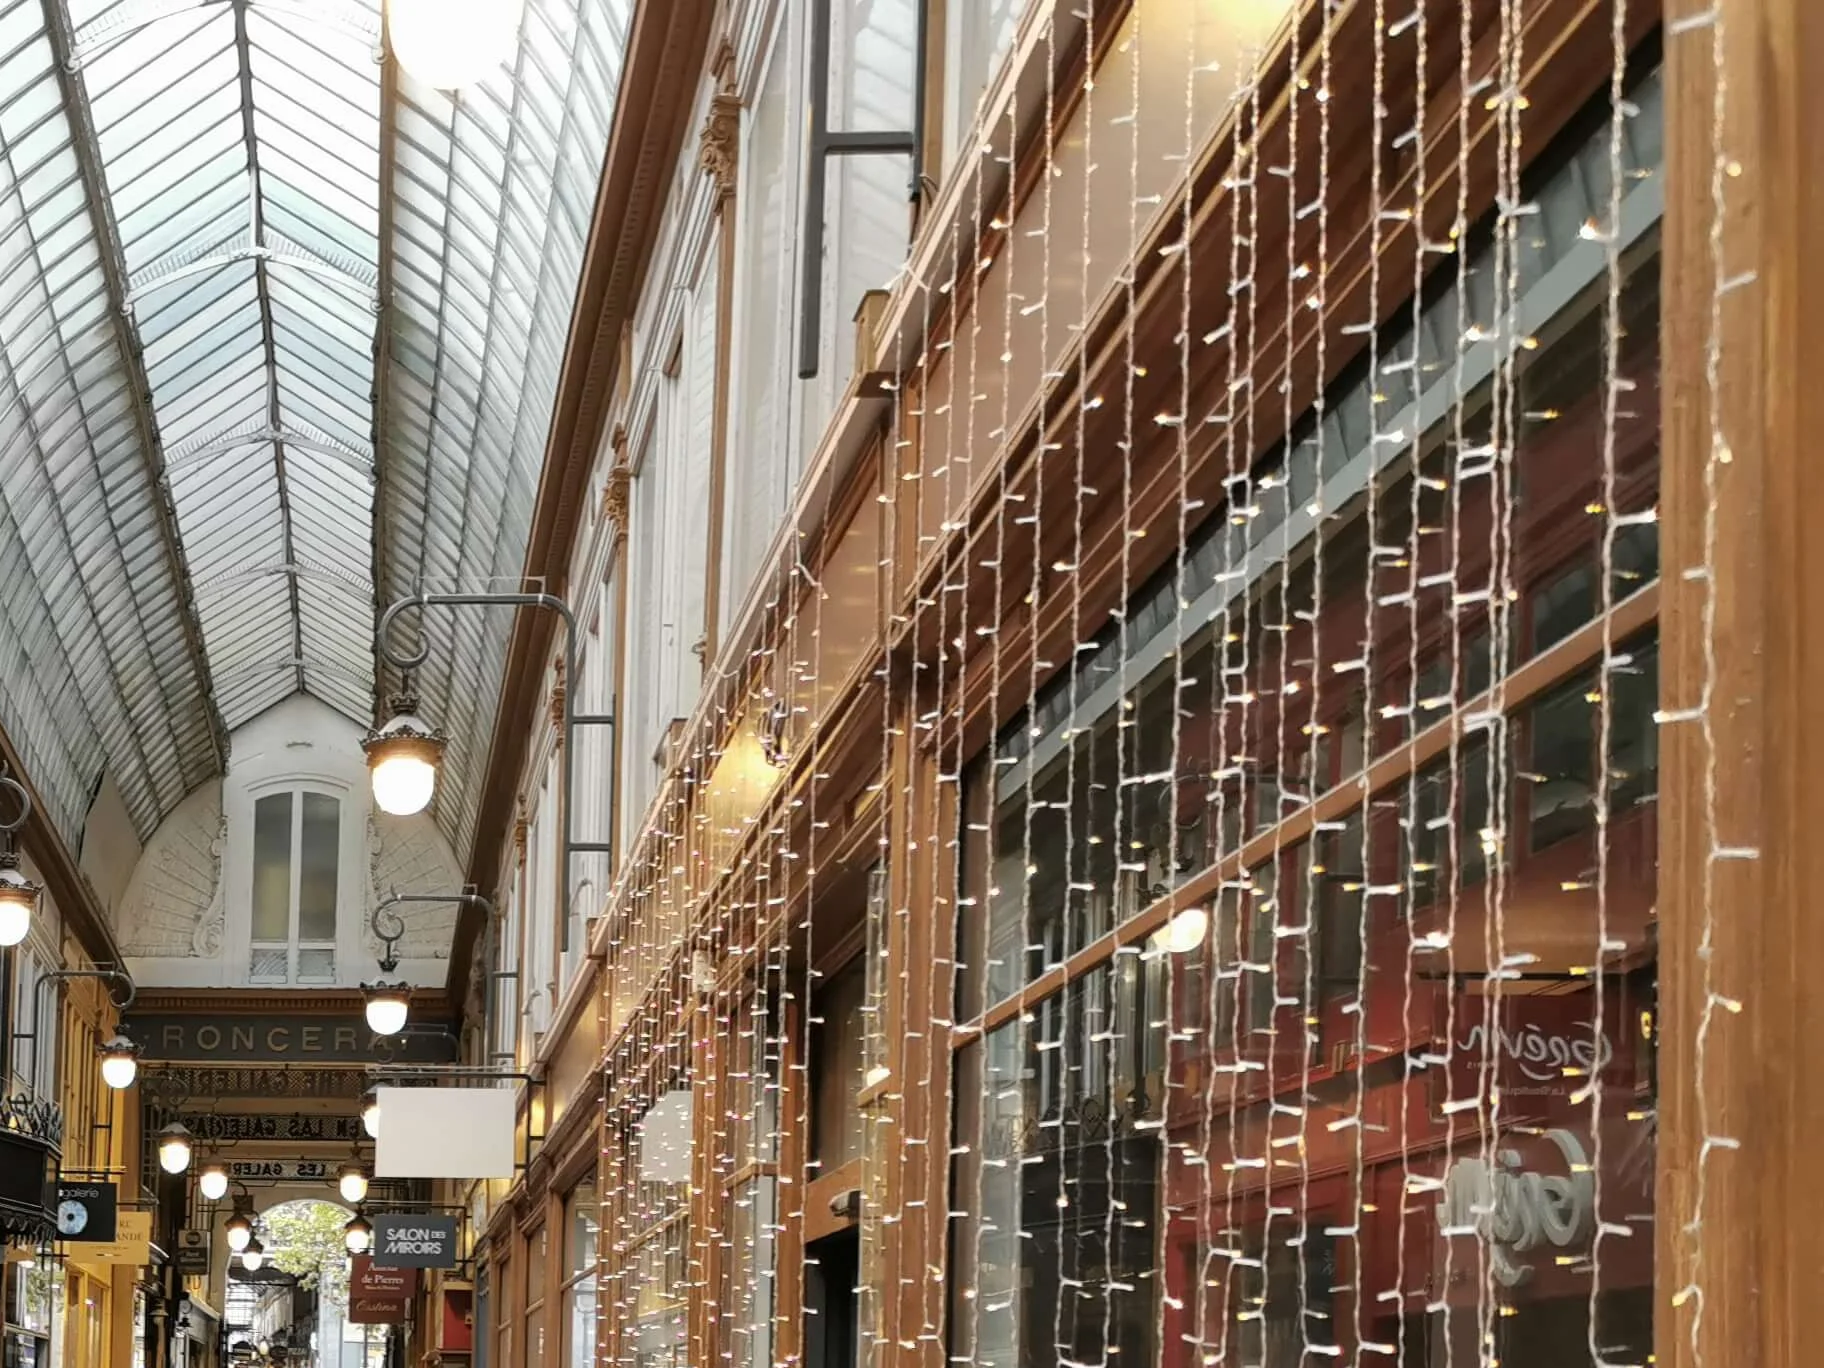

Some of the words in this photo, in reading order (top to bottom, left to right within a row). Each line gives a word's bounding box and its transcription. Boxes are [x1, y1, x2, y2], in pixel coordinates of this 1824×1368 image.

[386, 1228, 429, 1241] SALON
[431, 1231, 446, 1239] DES
[384, 1241, 442, 1254] MIROIRS
